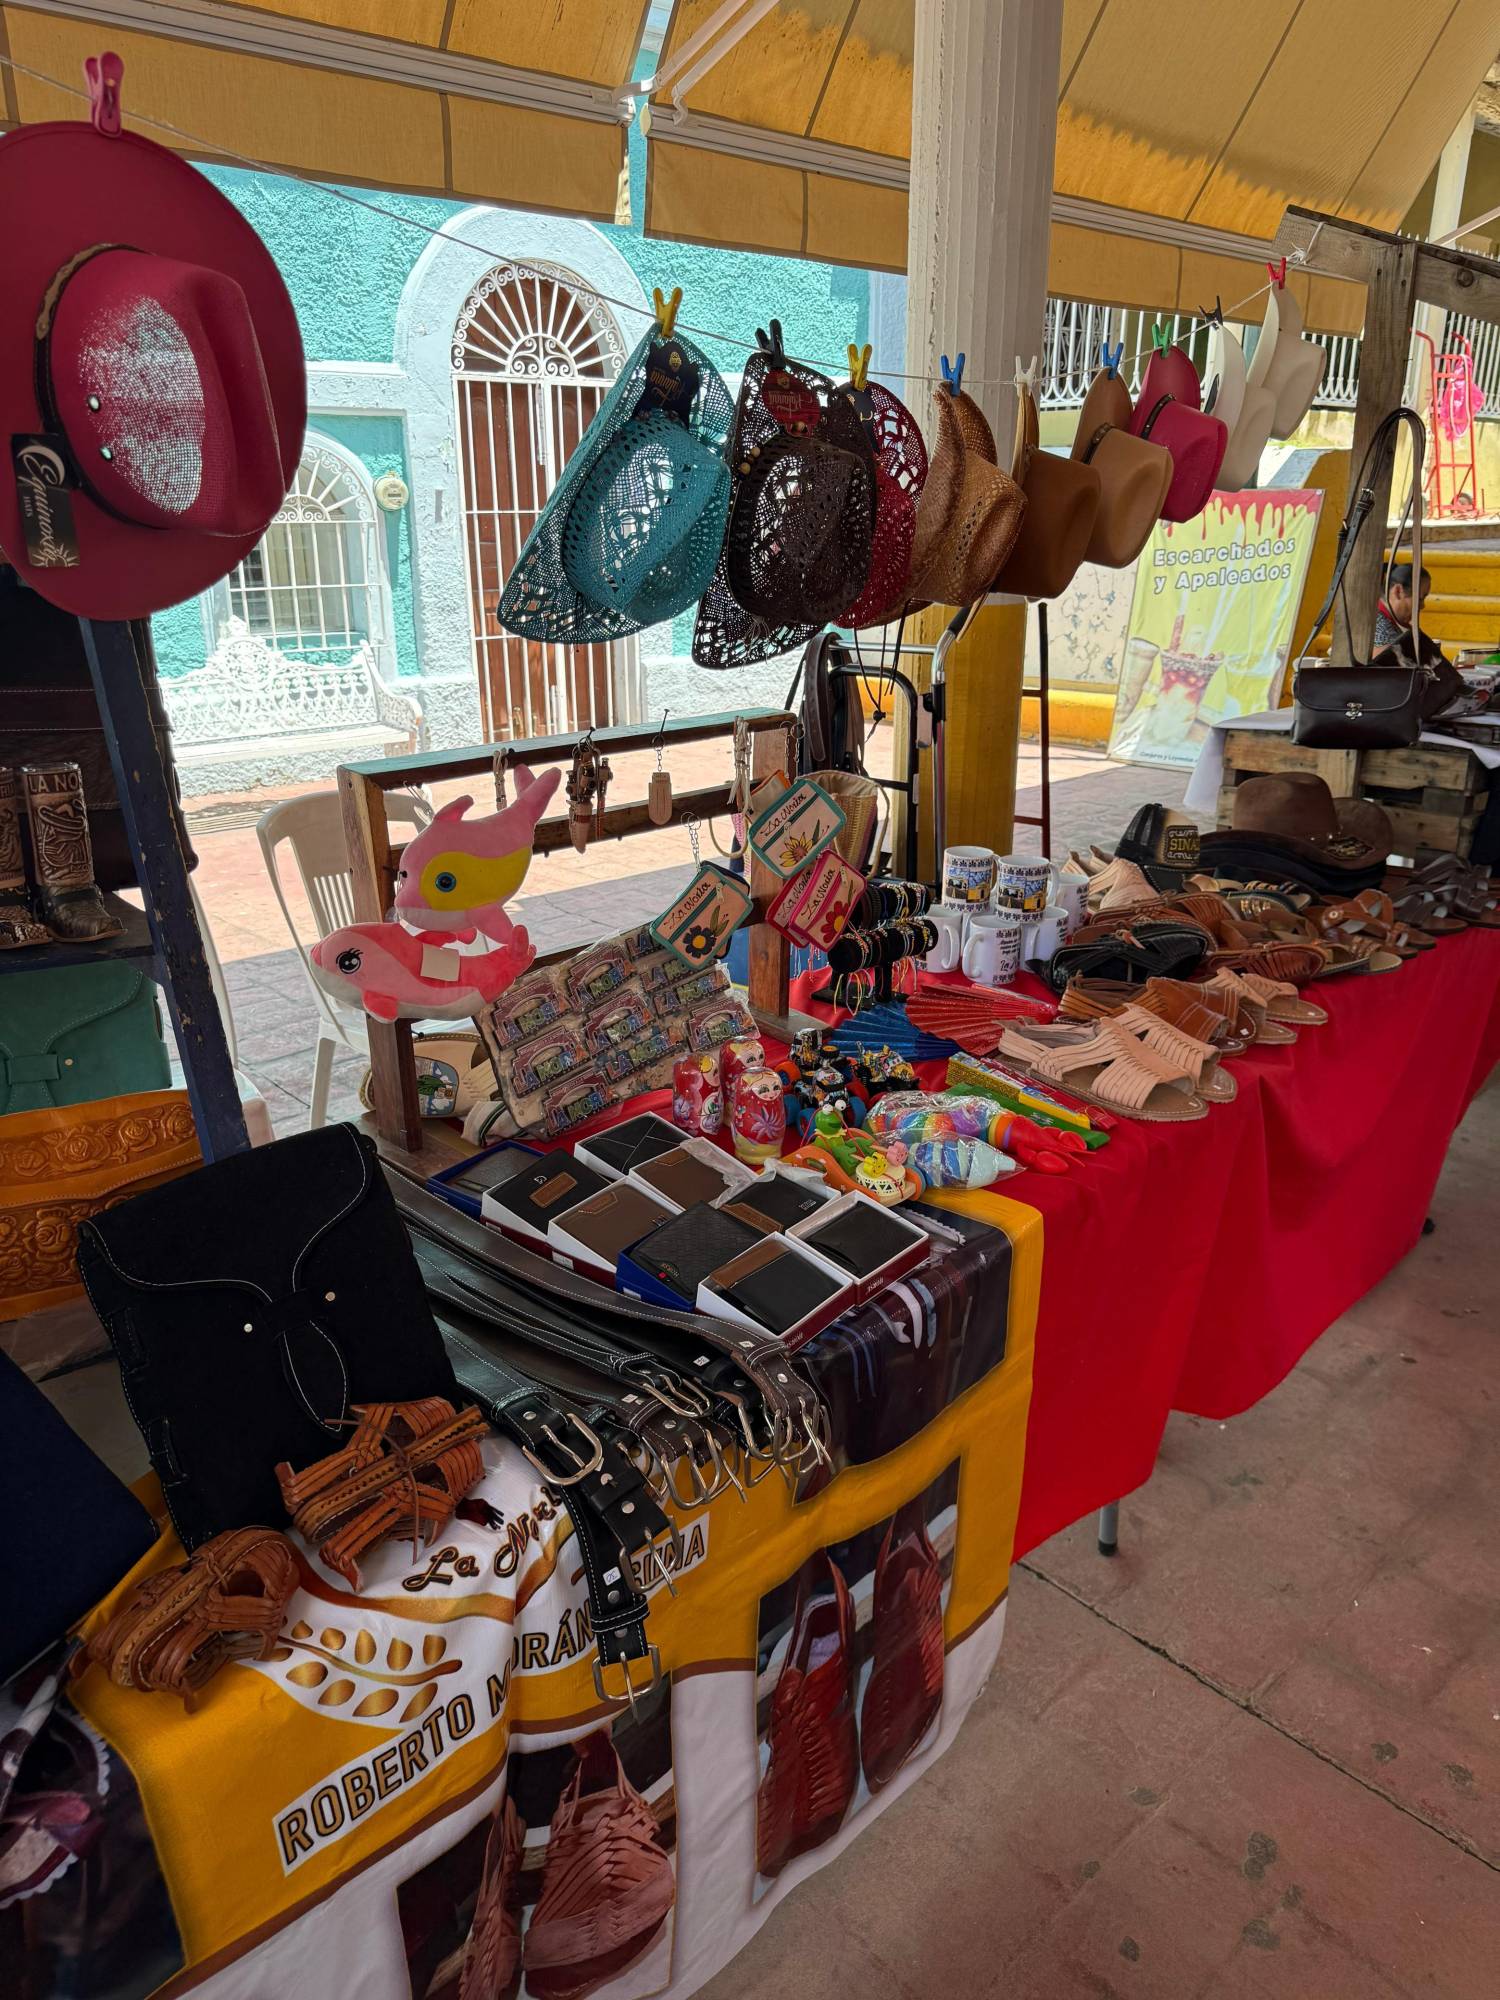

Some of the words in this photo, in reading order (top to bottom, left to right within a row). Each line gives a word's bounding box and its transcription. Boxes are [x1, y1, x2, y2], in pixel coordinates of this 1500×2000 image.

[1153, 537, 1296, 567] Escarchados
[1153, 575, 1167, 595] y
[1174, 563, 1292, 592] Apaleados
[29, 773, 49, 793] LA
[1169, 837, 1201, 852] SINA
[816, 869, 836, 899] Noria
[402, 1546, 480, 1592] La
[493, 1486, 563, 1578] Nori
[279, 1693, 475, 1866] ROBERTO
